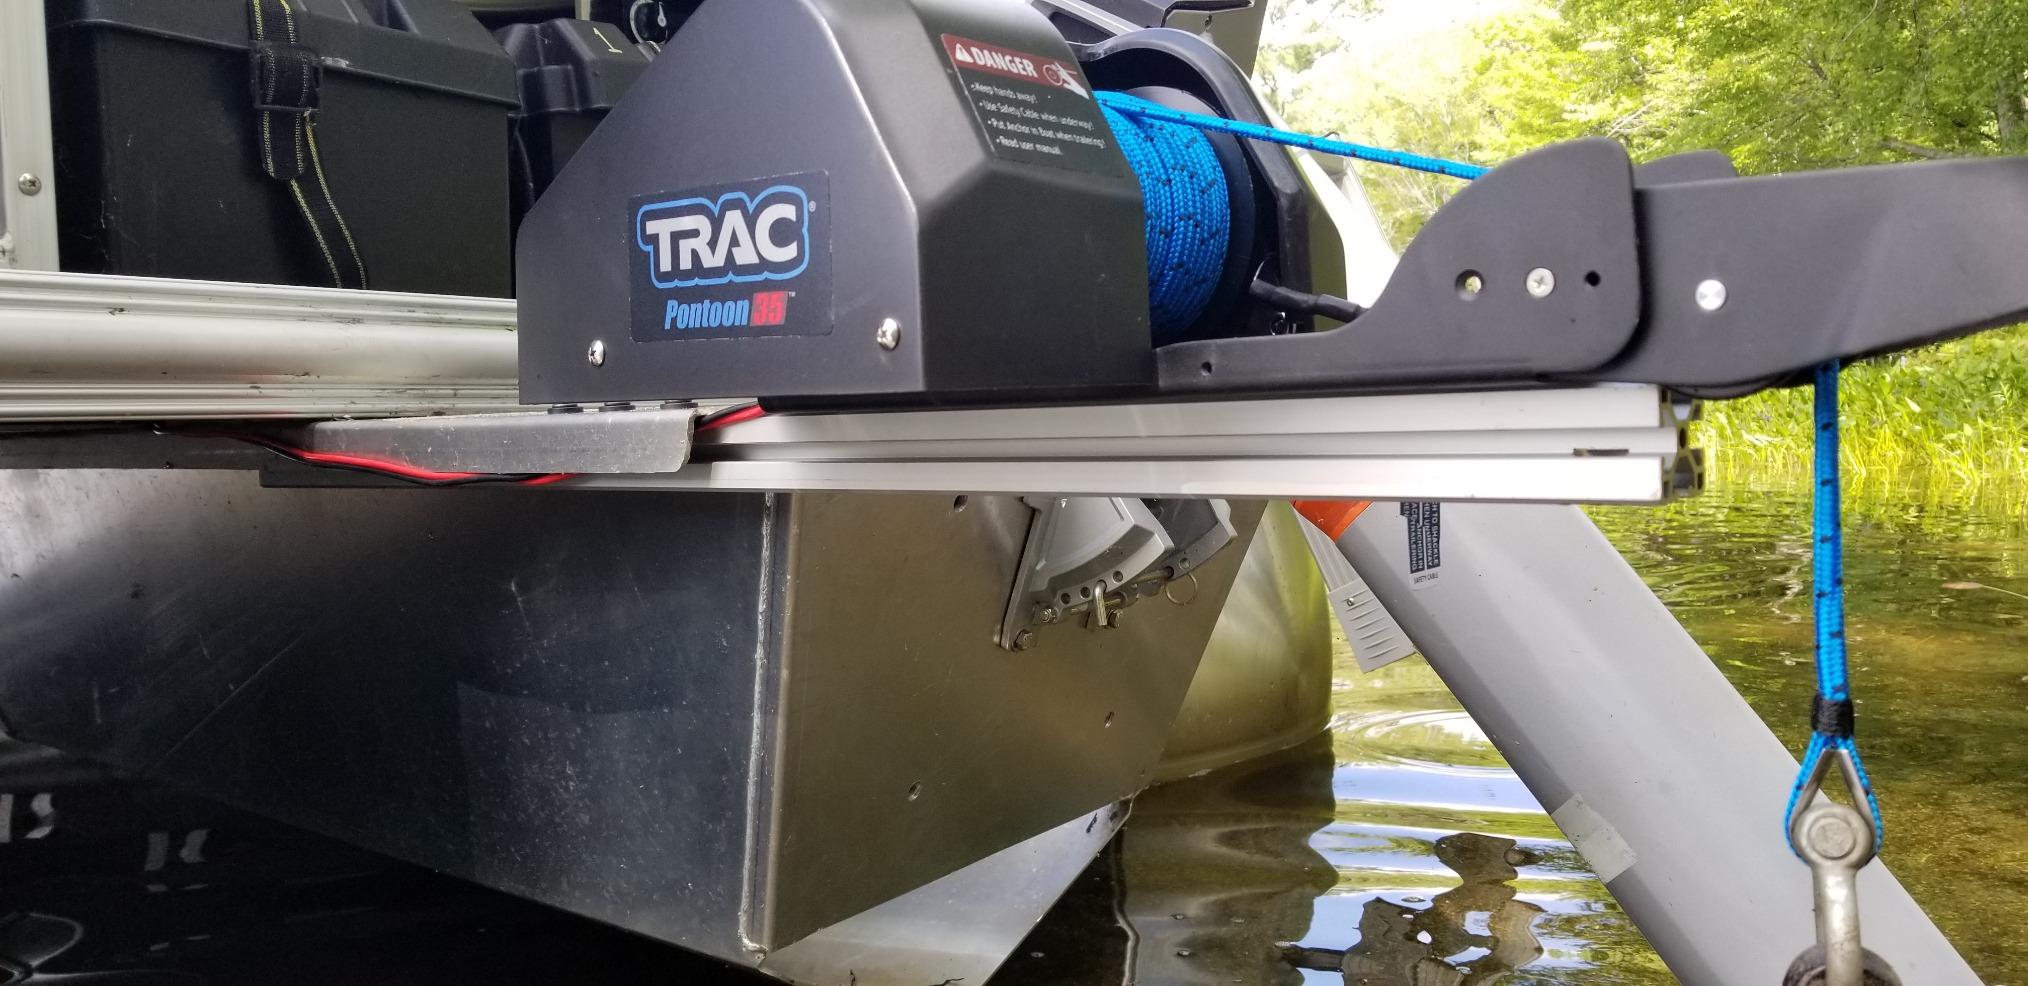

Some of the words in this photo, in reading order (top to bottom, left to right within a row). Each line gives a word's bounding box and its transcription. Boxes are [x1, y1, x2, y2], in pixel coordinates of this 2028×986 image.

[970, 46, 1038, 78] DANGER
[974, 82, 994, 95] Keep
[994, 86, 1016, 98] hands
[998, 103, 1021, 118] Safety
[1020, 107, 1040, 120] Cable
[1040, 112, 1058, 123] when
[1006, 122, 1031, 134] Anchor
[1039, 126, 1056, 139] Boat
[1056, 130, 1073, 141] when
[1000, 135, 1019, 148] Read
[1019, 140, 1035, 151] user
[645, 203, 798, 273] TRAC
[664, 298, 750, 330] Pontoon
[752, 291, 786, 326] 35
[1432, 511, 1438, 523] TO
[1431, 525, 1439, 565] SHACKLE
